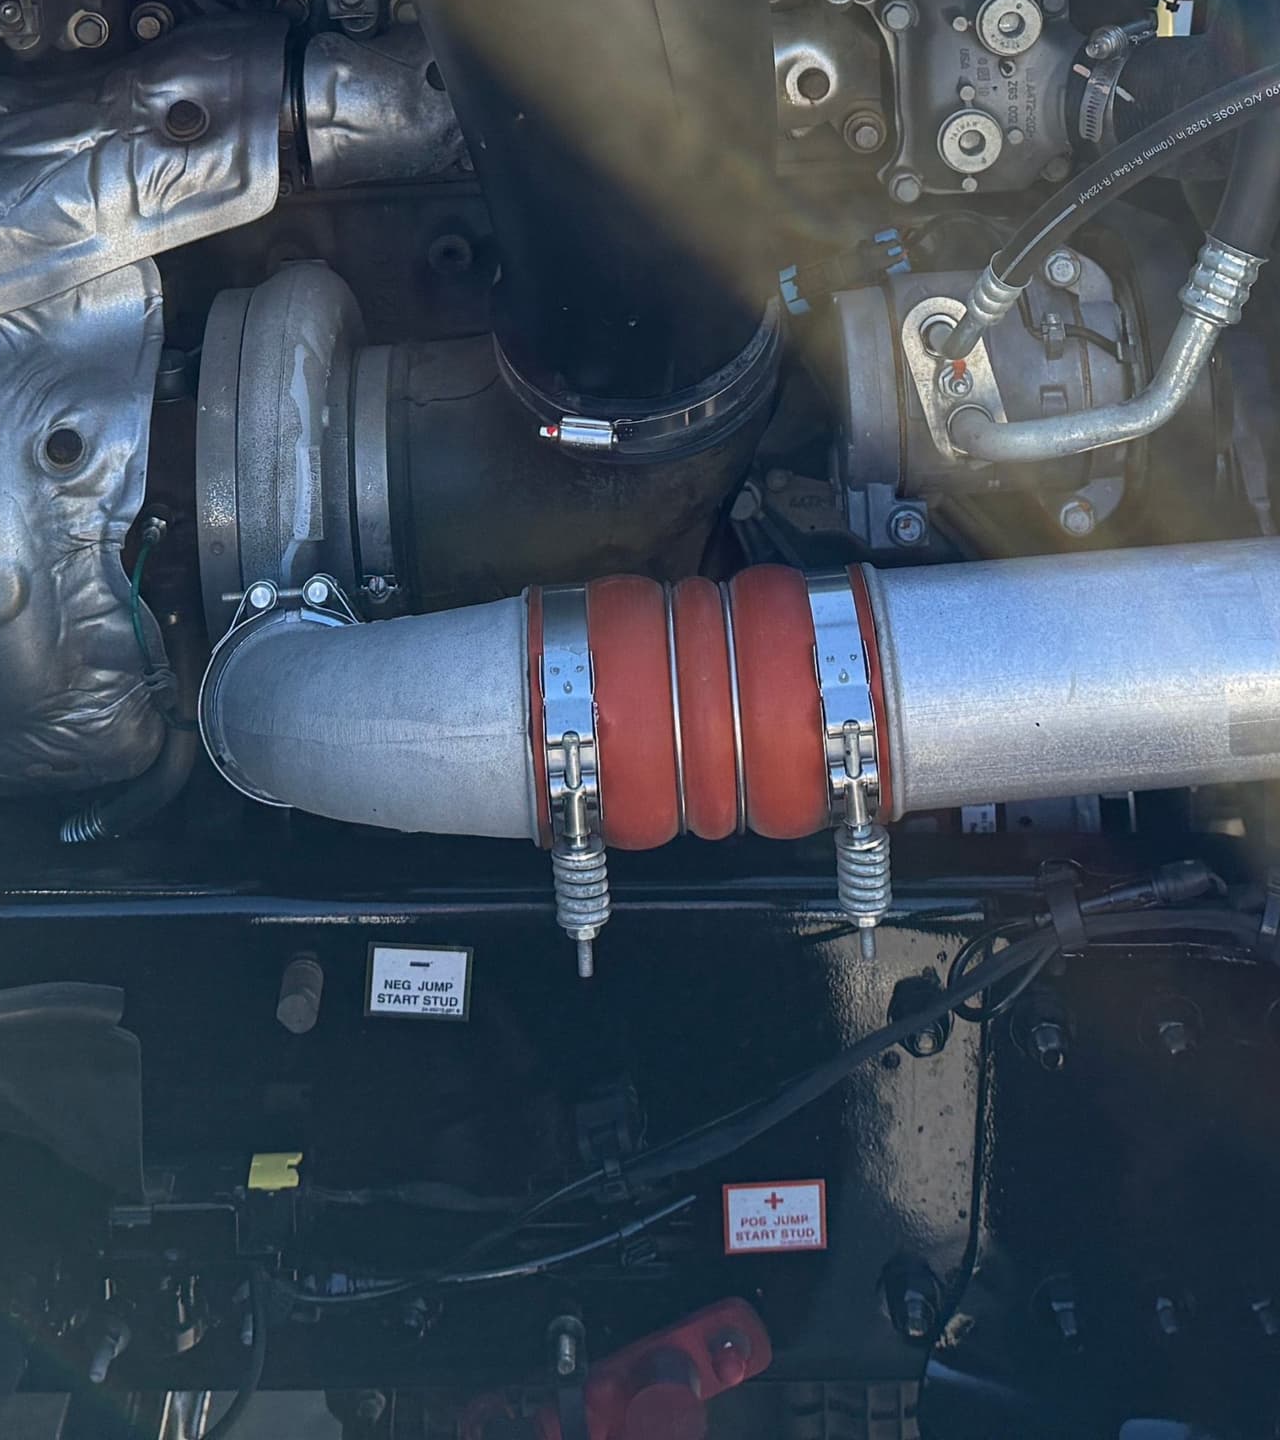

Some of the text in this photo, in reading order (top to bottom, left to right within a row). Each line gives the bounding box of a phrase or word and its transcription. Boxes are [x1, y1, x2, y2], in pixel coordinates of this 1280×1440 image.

[960, 47, 970, 70] USA
[1244, 94, 1263, 107] A/C
[1214, 102, 1244, 122] HOSE
[1186, 116, 1212, 135] 13/32
[1143, 136, 1176, 158] (10mm)
[1115, 156, 1142, 177] R-134a
[384, 979, 453, 992] NEG JUMP
[377, 993, 458, 1007] START STUD
[740, 1214, 809, 1227] POS JUMP
[735, 1227, 815, 1241] START STUD
